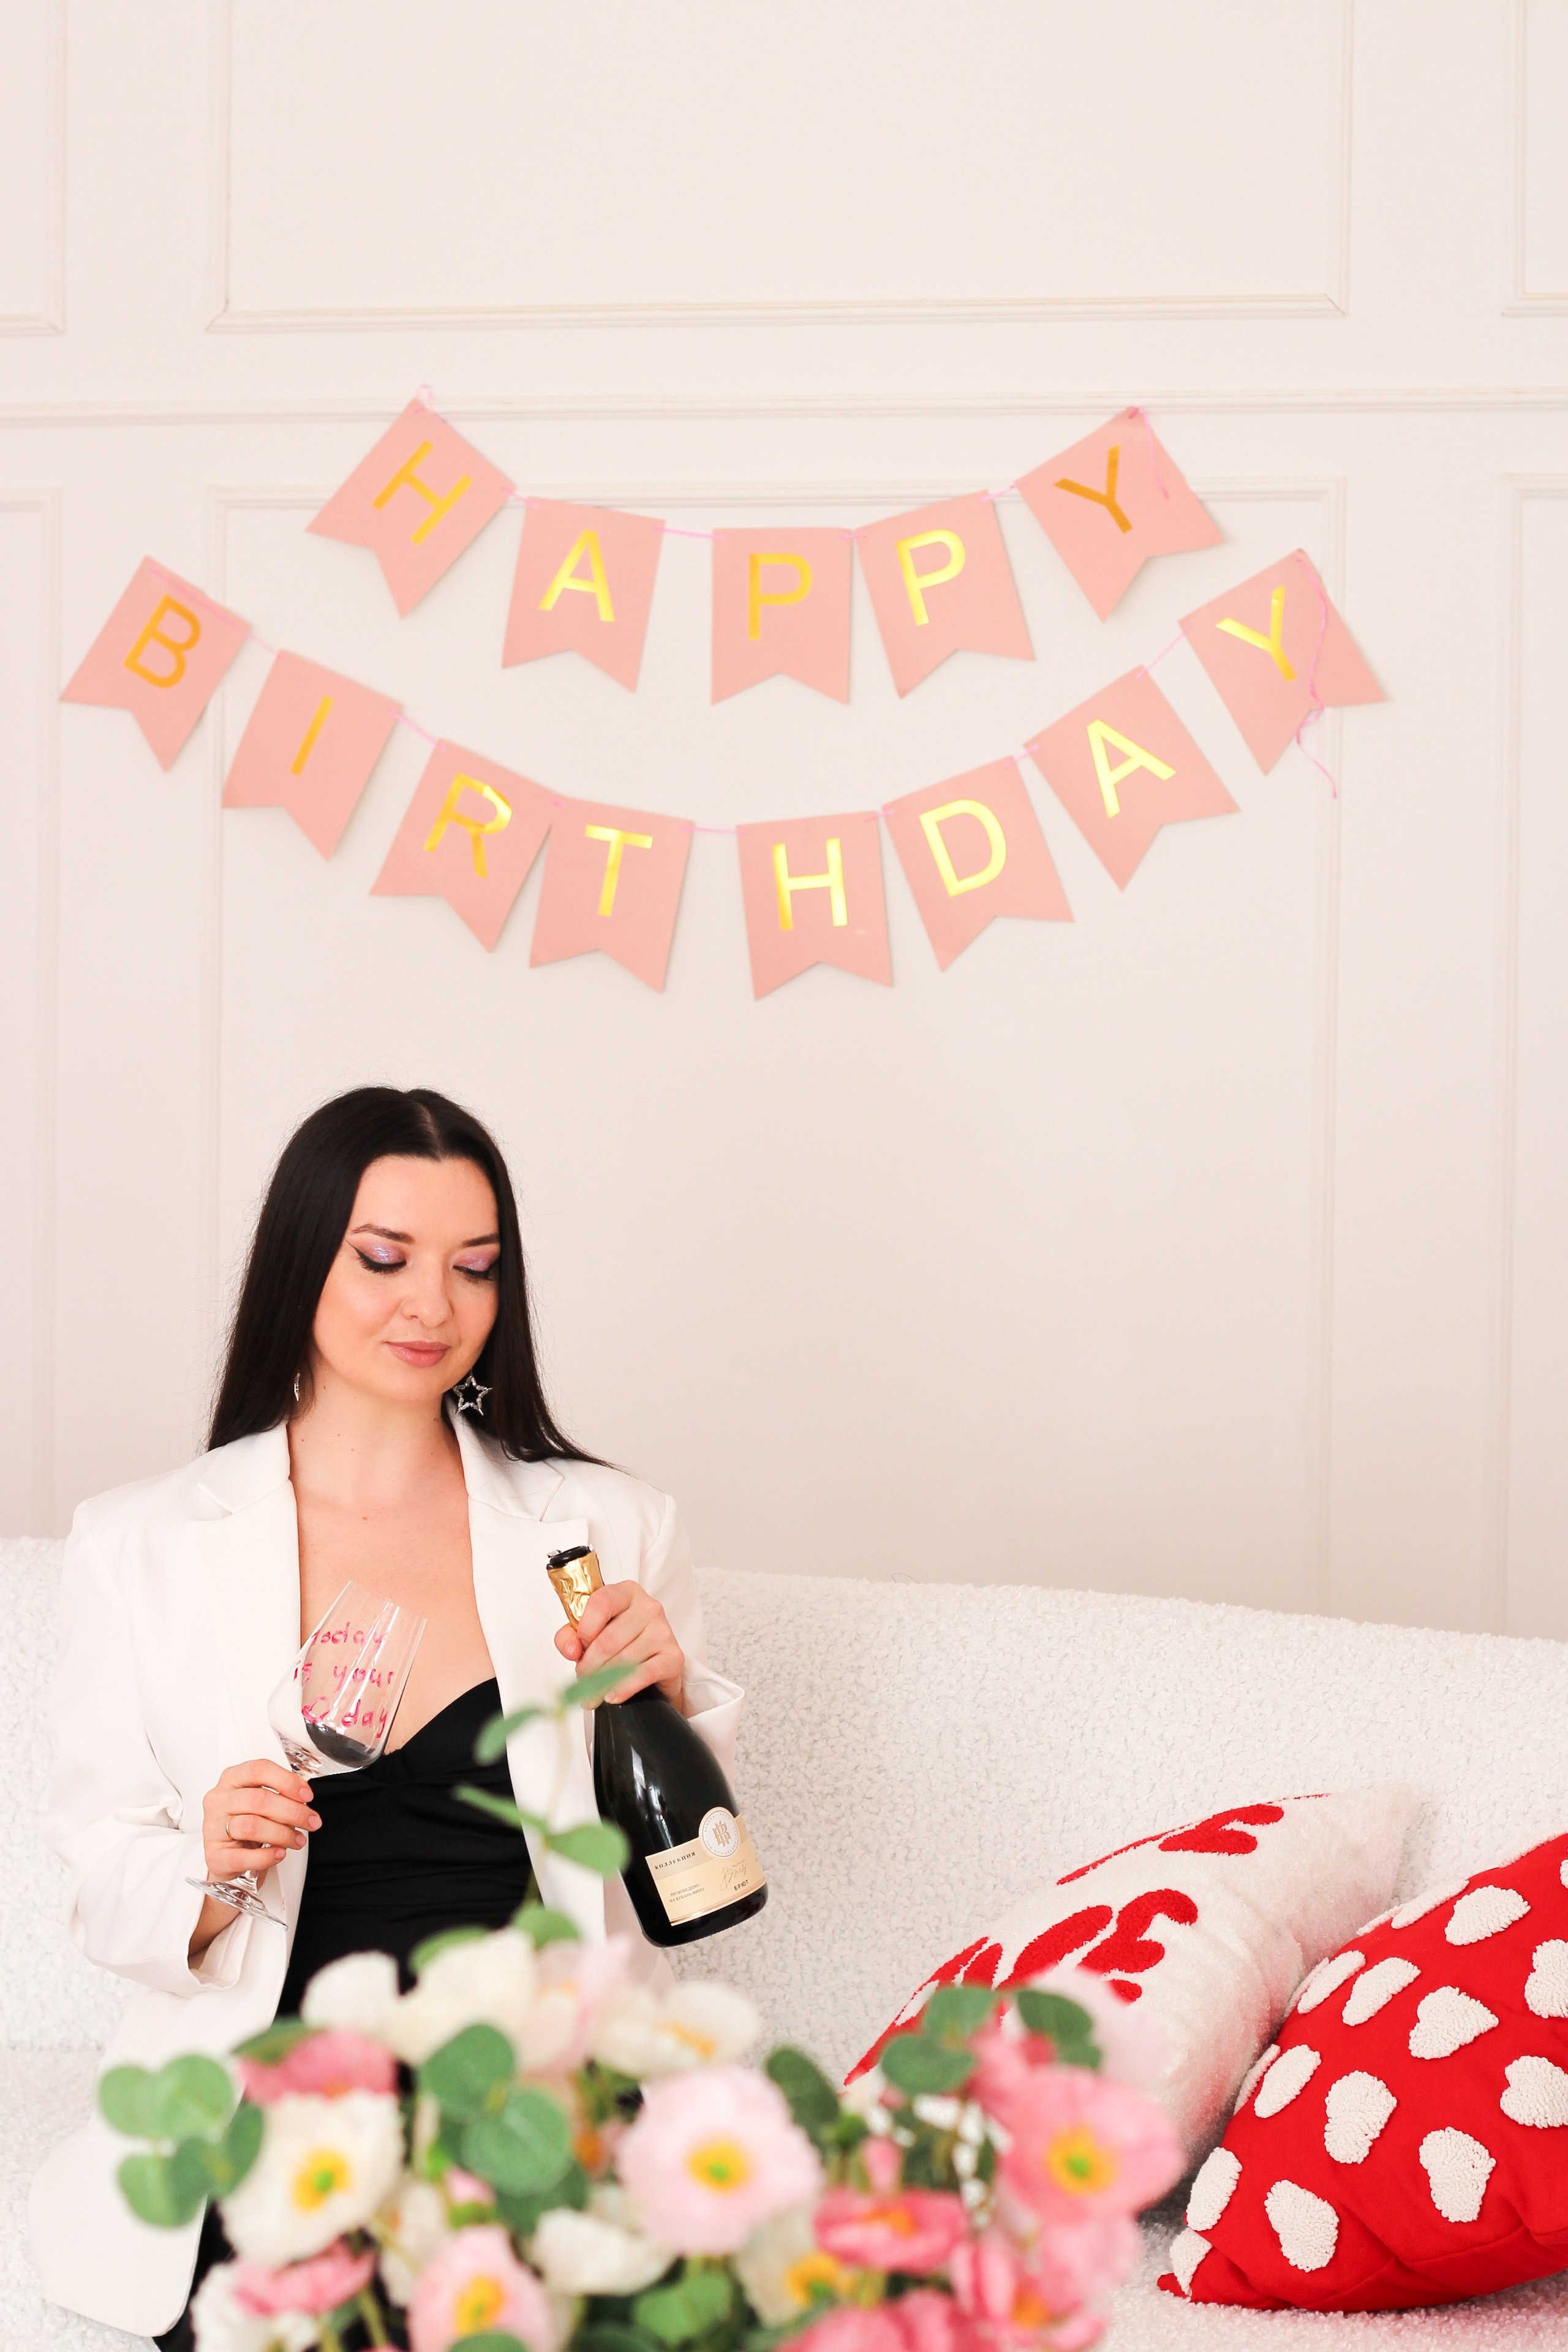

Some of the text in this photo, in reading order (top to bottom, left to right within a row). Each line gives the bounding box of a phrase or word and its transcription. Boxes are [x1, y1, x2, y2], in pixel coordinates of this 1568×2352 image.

[372, 440, 1132, 640] HAPPY
[124, 585, 1295, 930] BIRTHDAY
[293, 1660, 395, 1693] is your
[655, 1852, 696, 1870] КОЛЛЕКЦИЯ
[734, 1879, 748, 1891] БРЮТ
